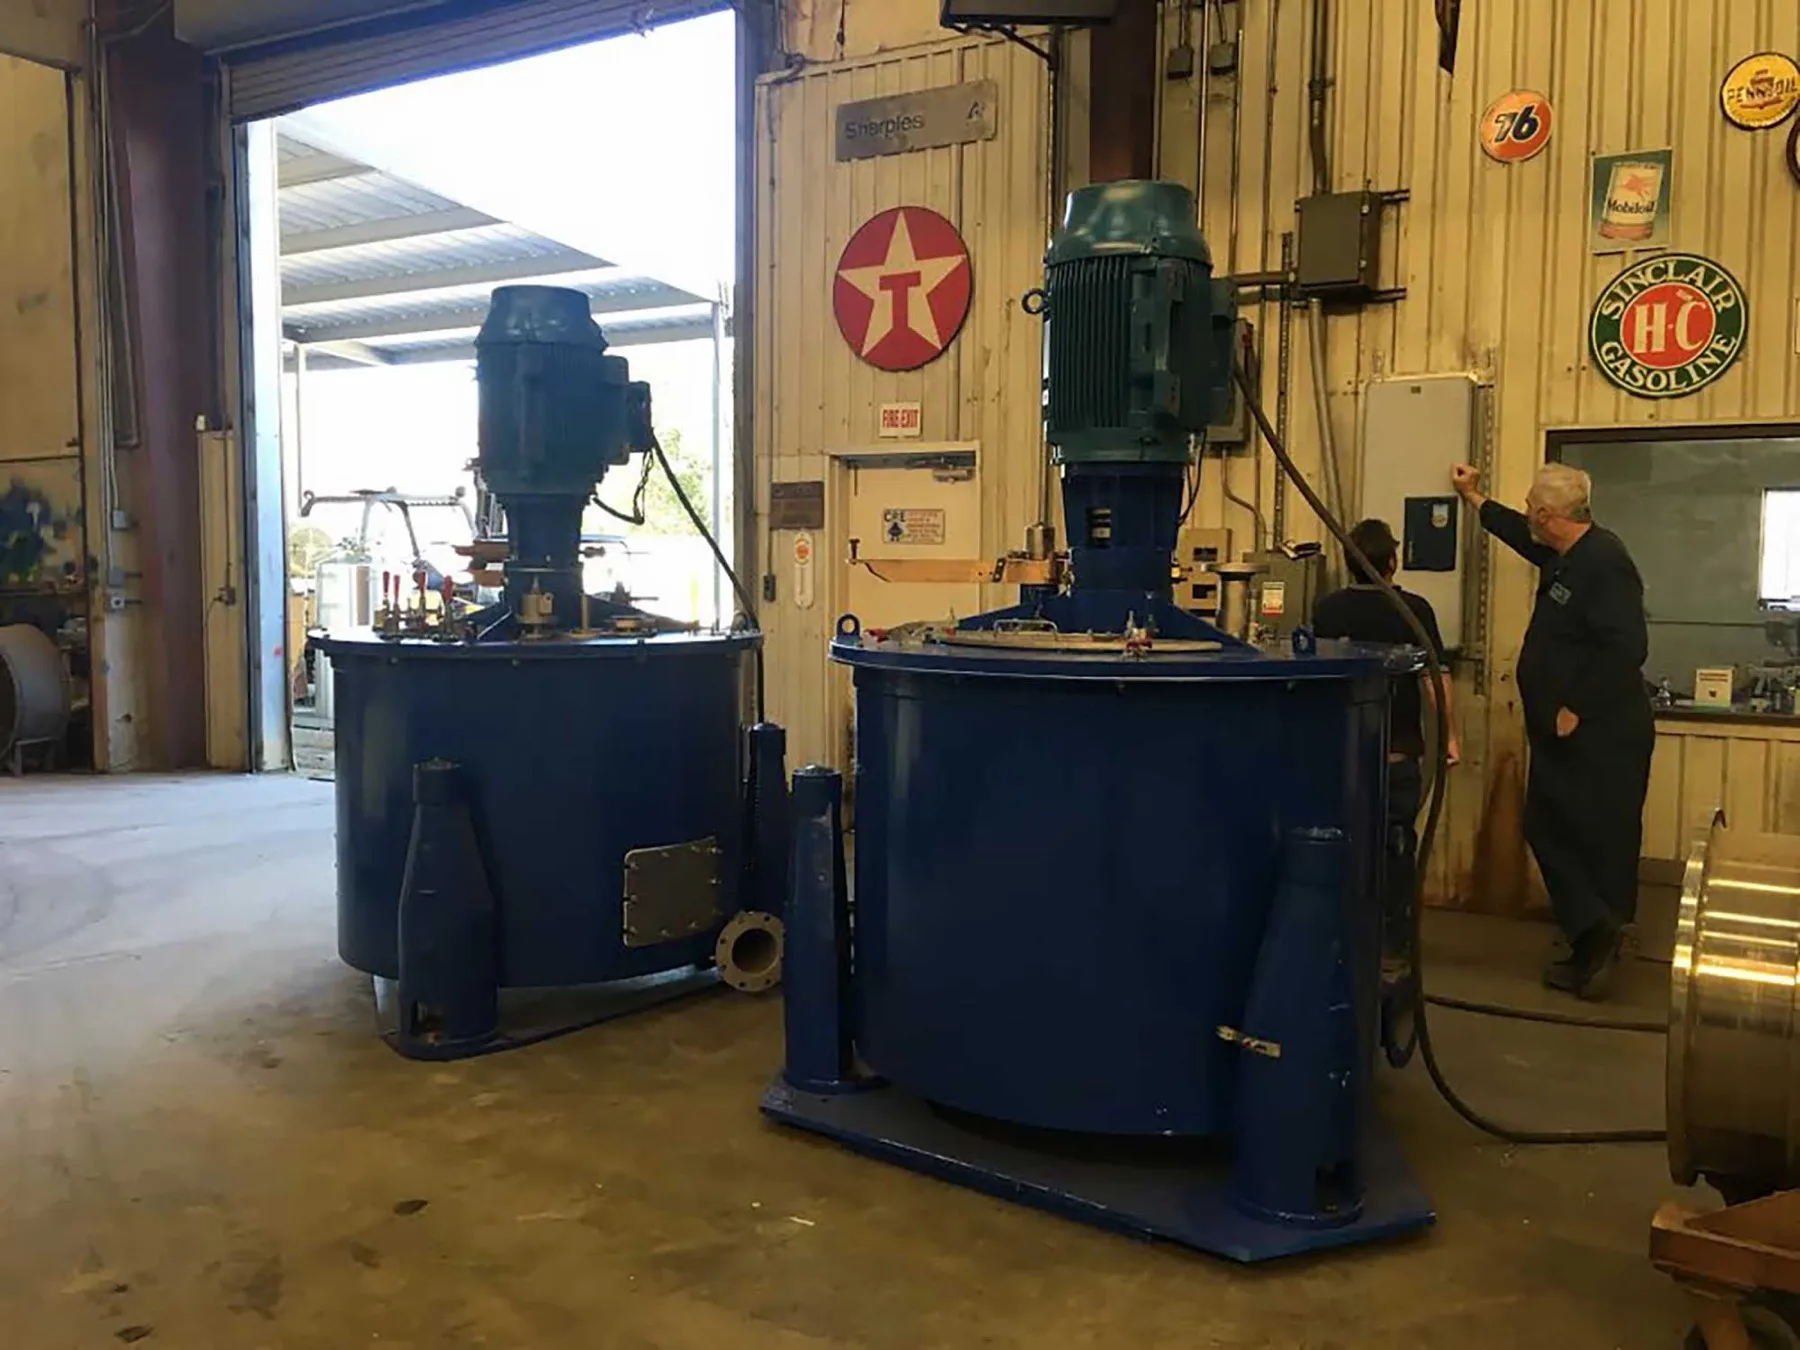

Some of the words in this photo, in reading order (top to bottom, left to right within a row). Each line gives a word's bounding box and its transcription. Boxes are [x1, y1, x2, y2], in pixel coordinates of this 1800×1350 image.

[845, 114, 925, 140] Sharples
[1494, 105, 1539, 143] 76
[1606, 199, 1655, 214] Mobiloil
[1601, 261, 1735, 320] SINCLAIR
[1600, 334, 1736, 390] GASOLINE
[882, 409, 899, 428] FIRE
[901, 409, 918, 428] EXIT
